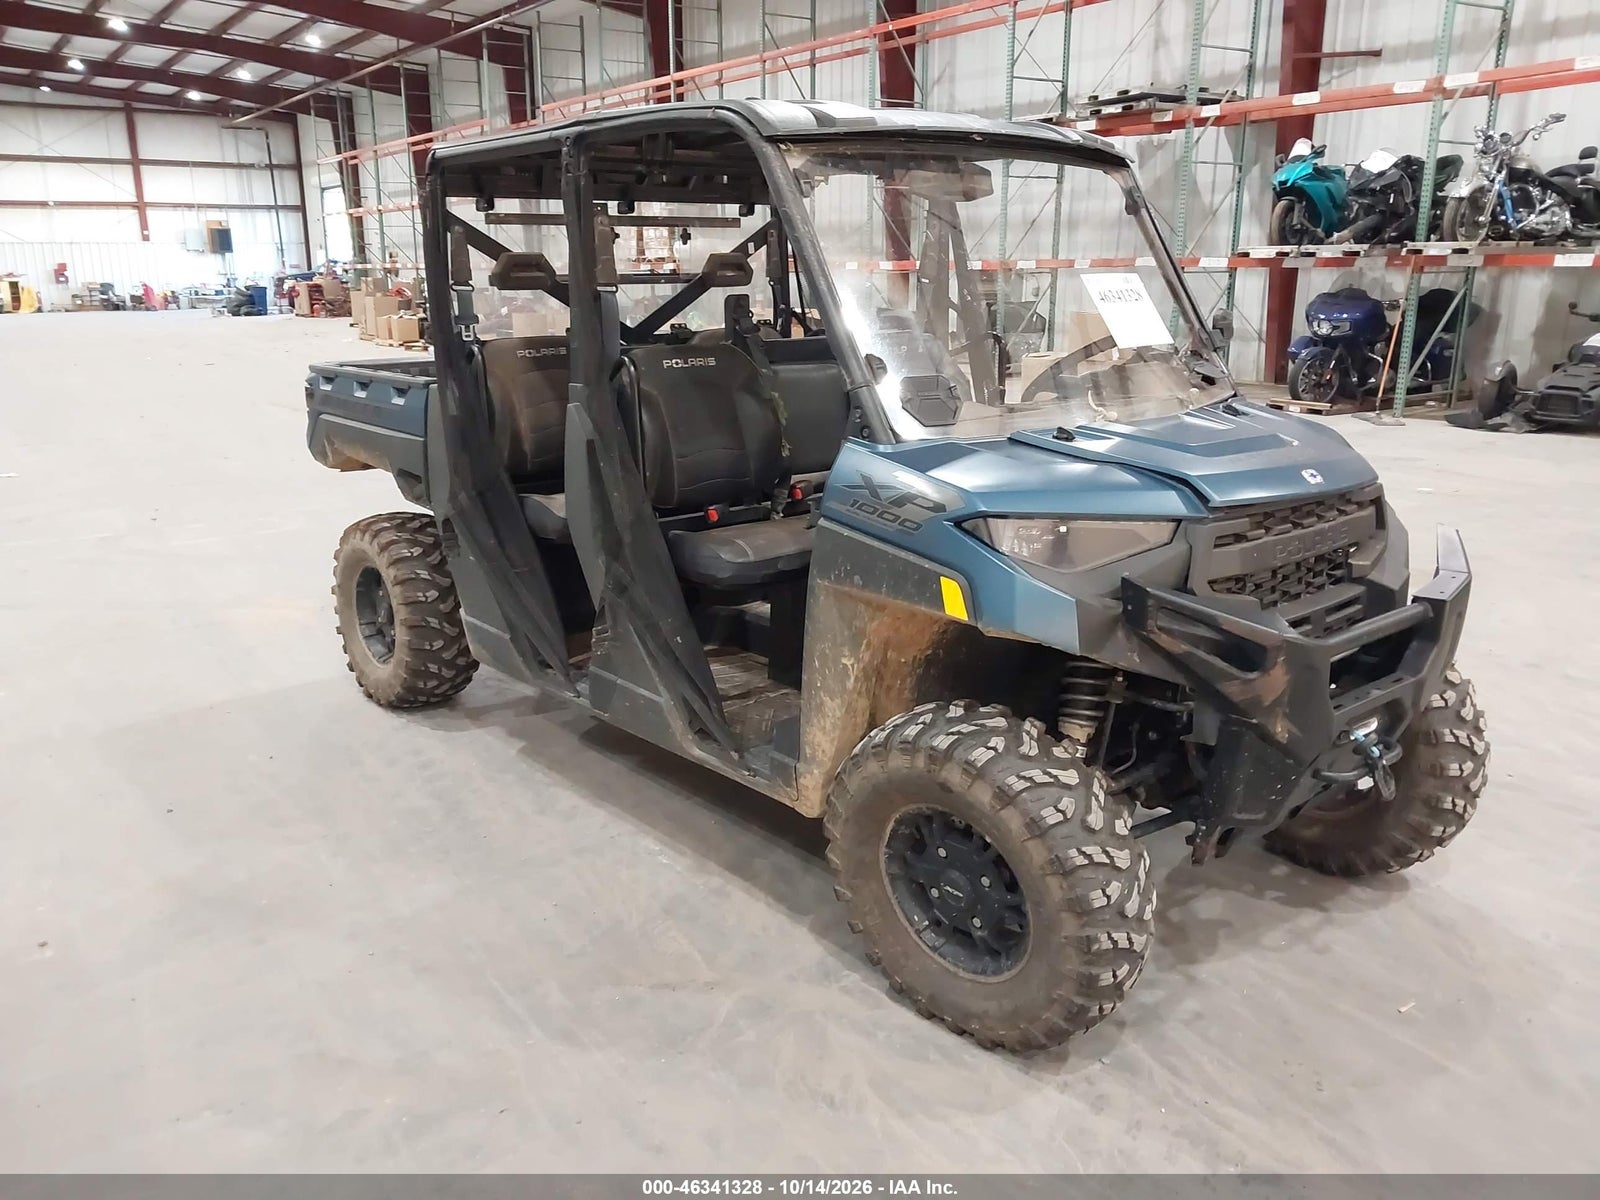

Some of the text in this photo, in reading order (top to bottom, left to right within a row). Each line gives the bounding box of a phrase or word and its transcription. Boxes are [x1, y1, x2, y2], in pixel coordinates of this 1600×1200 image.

[516, 347, 567, 358] POLARIS
[662, 357, 717, 369] POLARIS
[839, 472, 948, 514] XP
[848, 498, 924, 532] 1000
